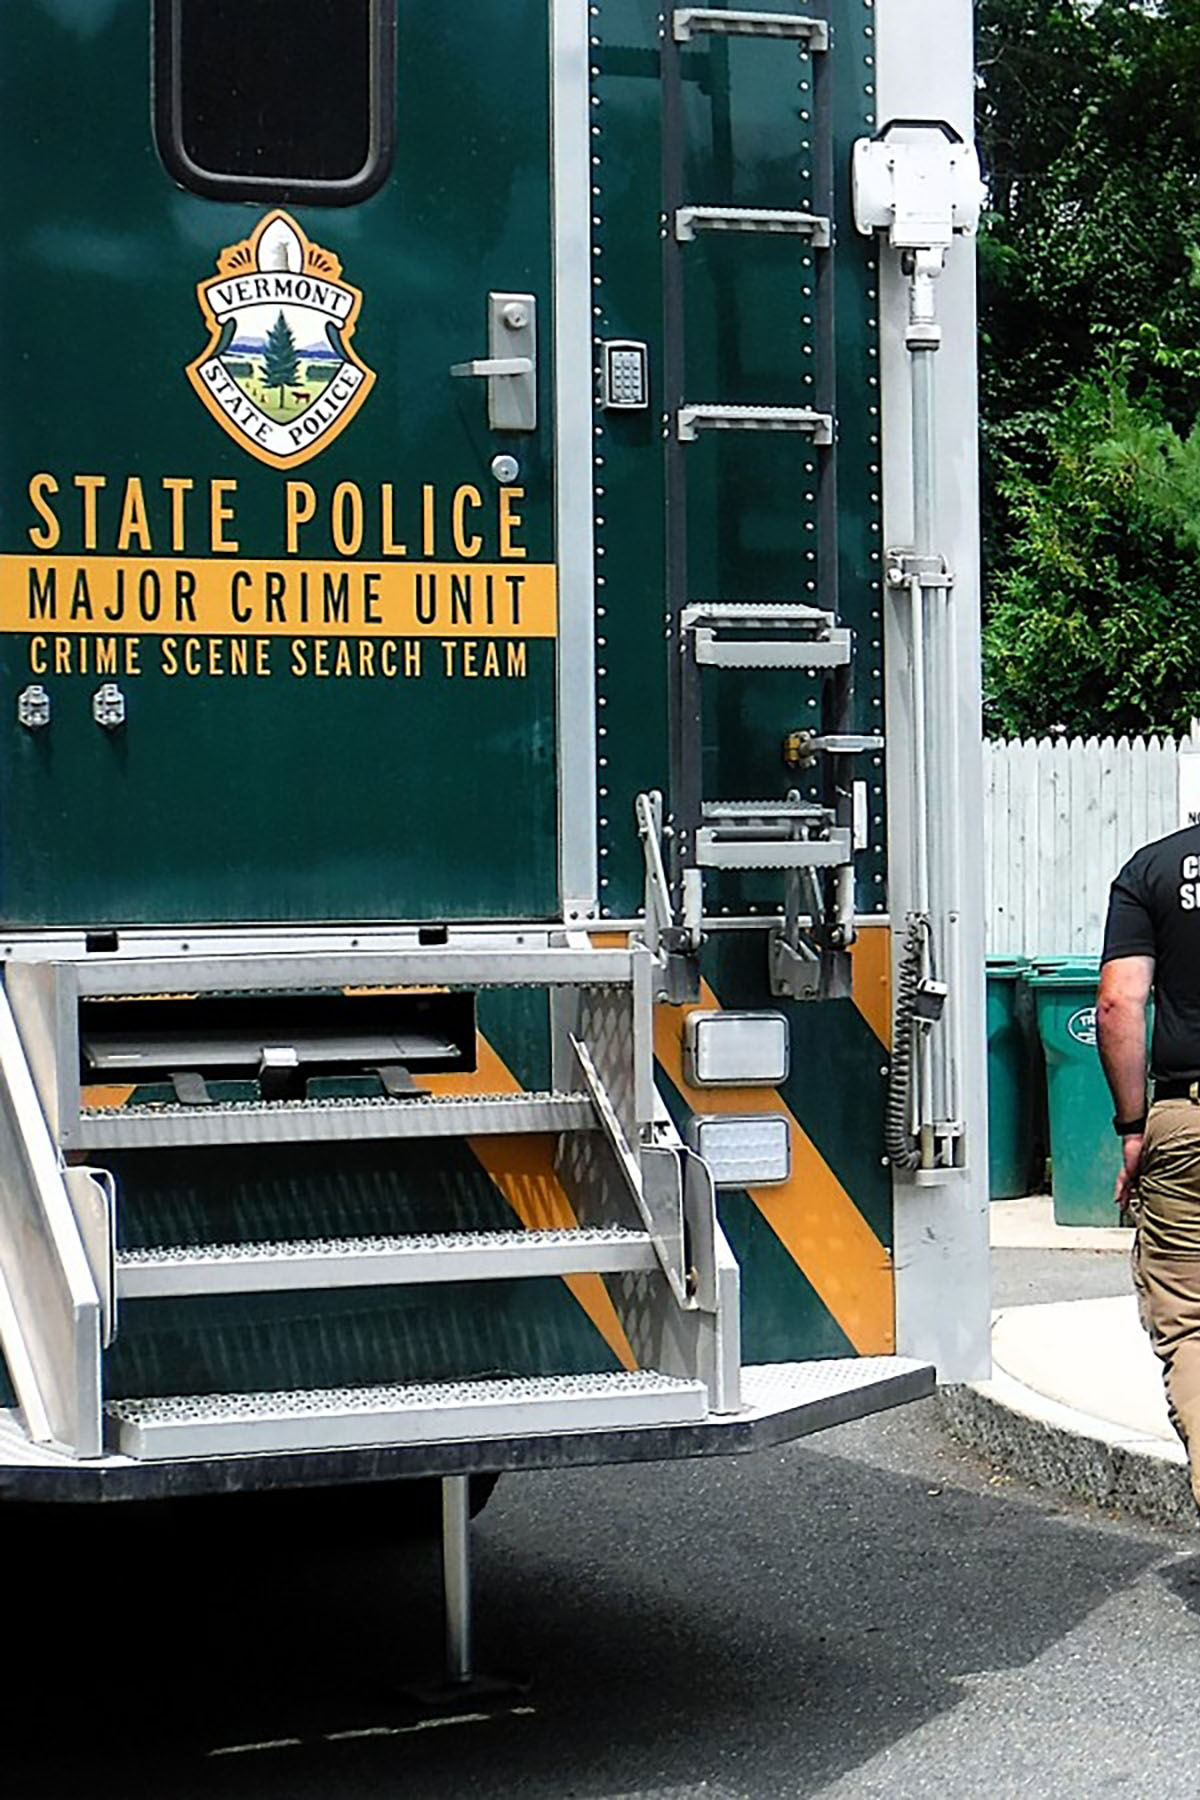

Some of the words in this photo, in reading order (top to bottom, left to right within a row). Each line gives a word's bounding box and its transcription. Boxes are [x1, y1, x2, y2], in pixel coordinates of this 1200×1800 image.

[216, 277, 347, 311] VERMONT
[205, 364, 274, 443] STATE
[287, 368, 359, 446] POLICE
[28, 472, 240, 553] STATE
[286, 480, 527, 558] POLICE
[27, 566, 197, 622] MAJOR
[230, 570, 383, 625] CRIME
[415, 573, 526, 626] UNIT
[30, 636, 142, 675] CRIME
[162, 637, 271, 676] SCENE
[291, 640, 422, 677] SEARCH
[442, 641, 527, 677] TEAM
